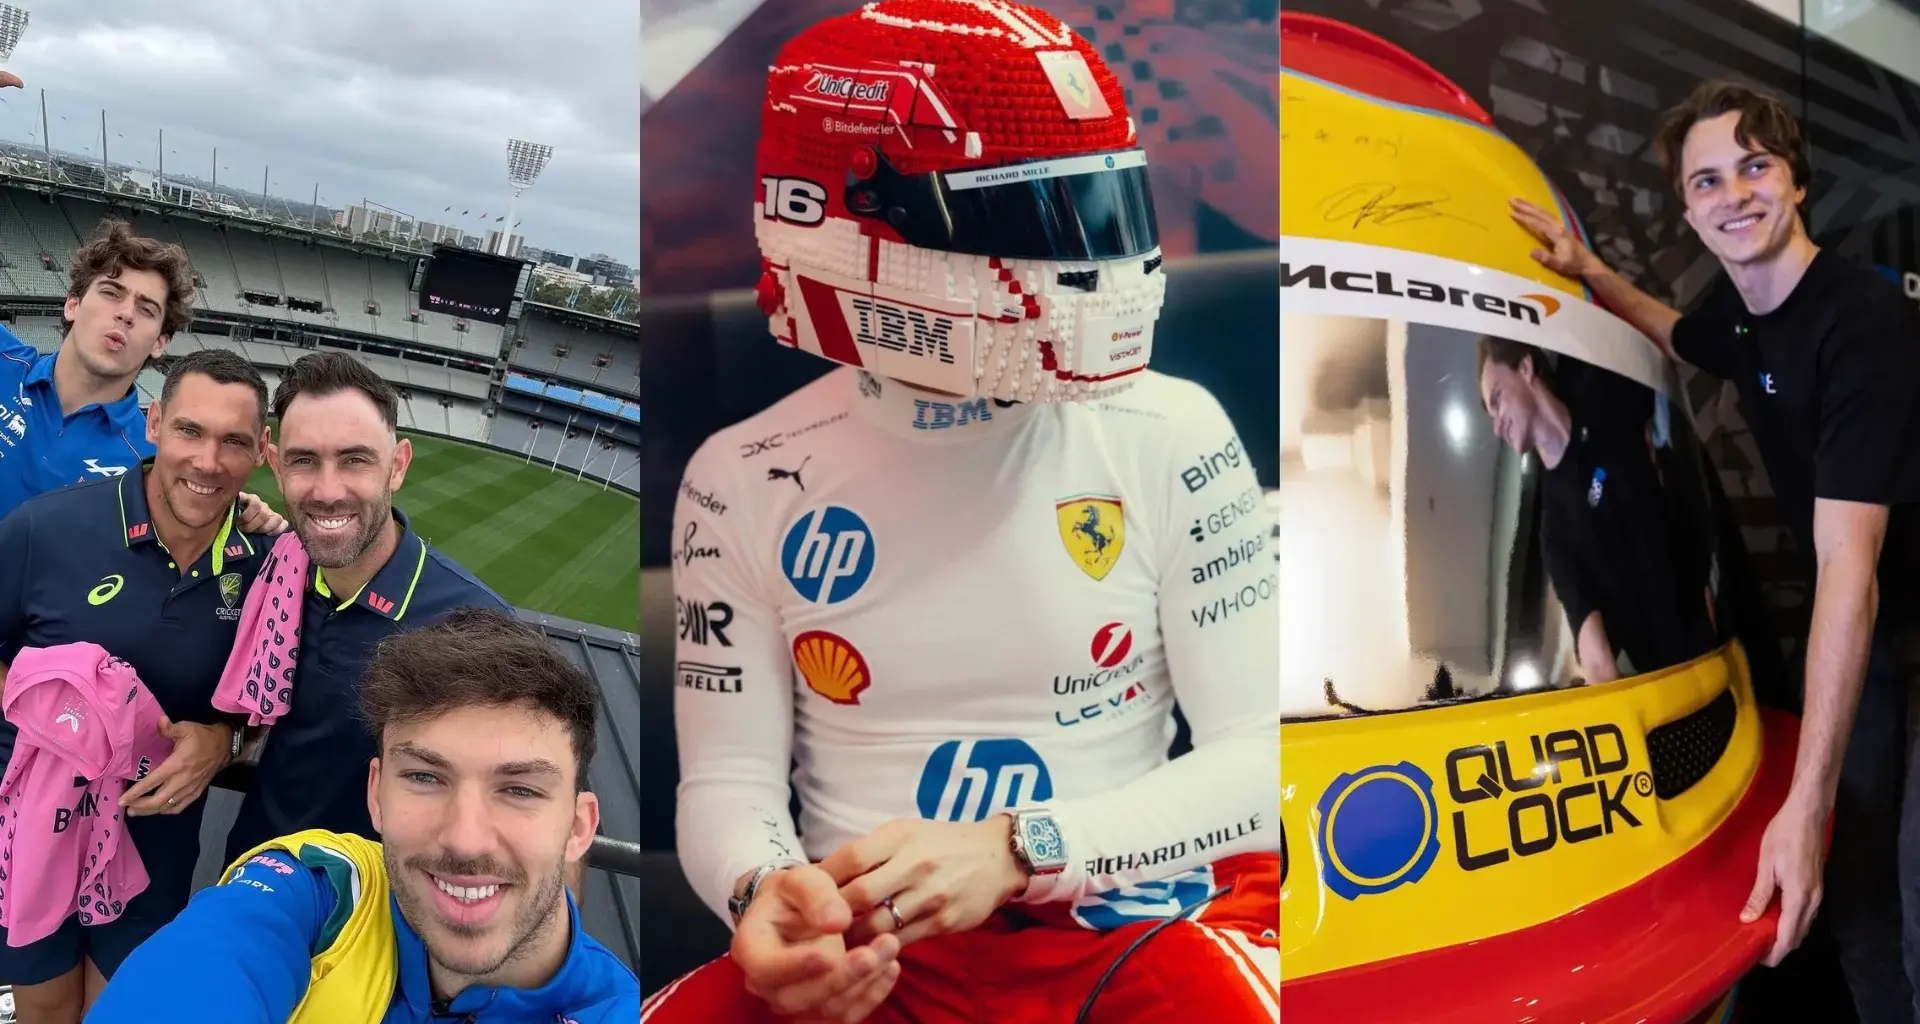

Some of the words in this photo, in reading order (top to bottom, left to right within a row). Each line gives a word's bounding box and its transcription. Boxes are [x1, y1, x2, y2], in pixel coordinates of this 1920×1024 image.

[819, 75, 889, 100] UniCredit
[835, 121, 895, 135] Bitdefender
[761, 173, 828, 227] 16
[975, 171, 1019, 184] RICHARD
[1022, 166, 1050, 178] MILLE
[852, 299, 955, 365] IBM
[912, 398, 993, 430] IBM
[1181, 434, 1242, 494] Bing
[786, 506, 872, 604] hp
[215, 607, 242, 616] CRICKET
[1445, 723, 1629, 804] QUAD
[1085, 841, 1186, 877] RICHARD
[1194, 812, 1263, 853] MILLE
